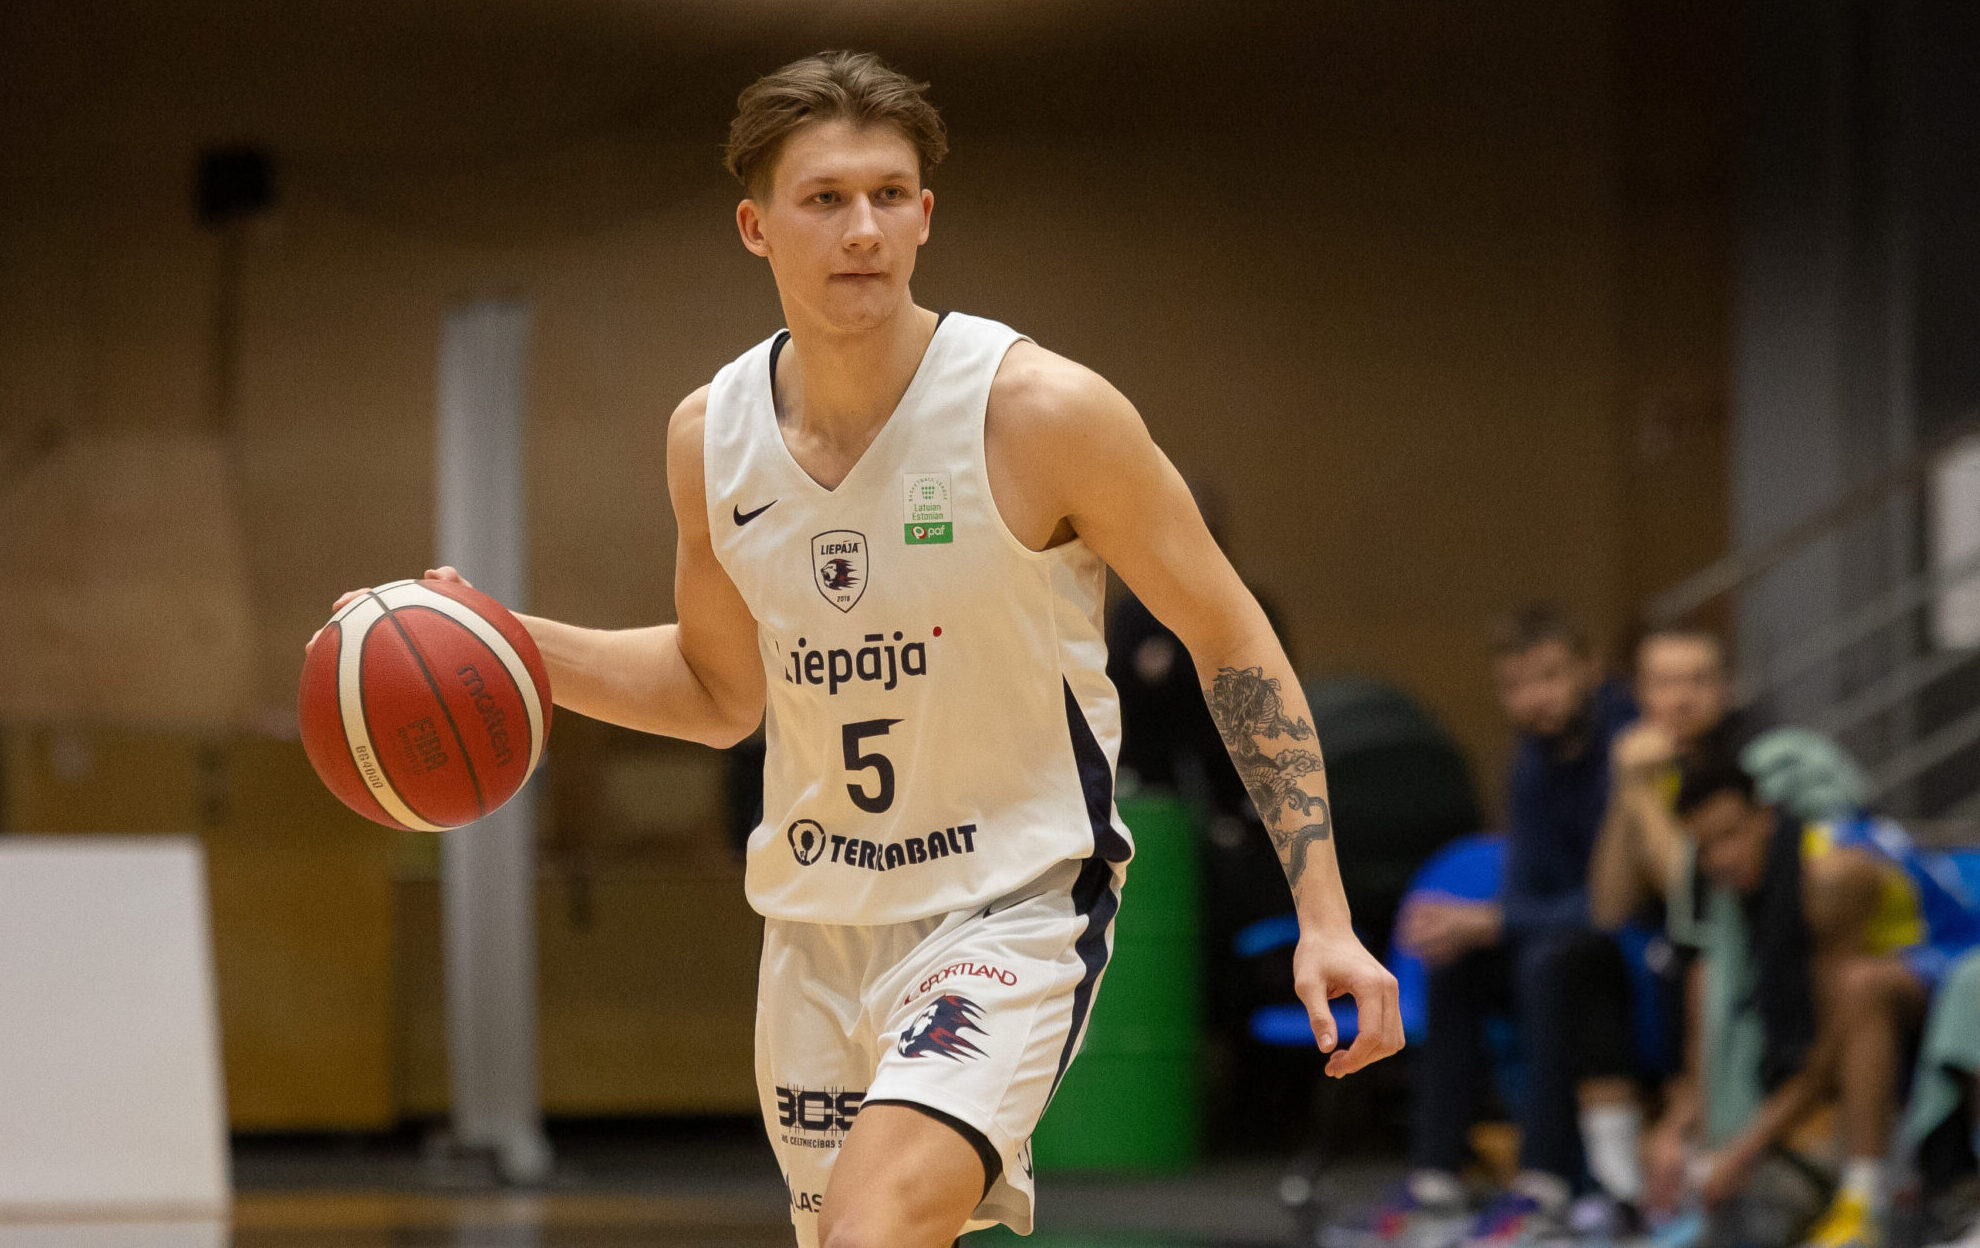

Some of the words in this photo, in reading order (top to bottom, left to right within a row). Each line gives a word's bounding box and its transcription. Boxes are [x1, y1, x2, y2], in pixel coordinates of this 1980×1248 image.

[911, 512, 944, 521] Estonian
[927, 524, 945, 539] paf
[456, 664, 513, 768] molten
[842, 718, 905, 814] 5
